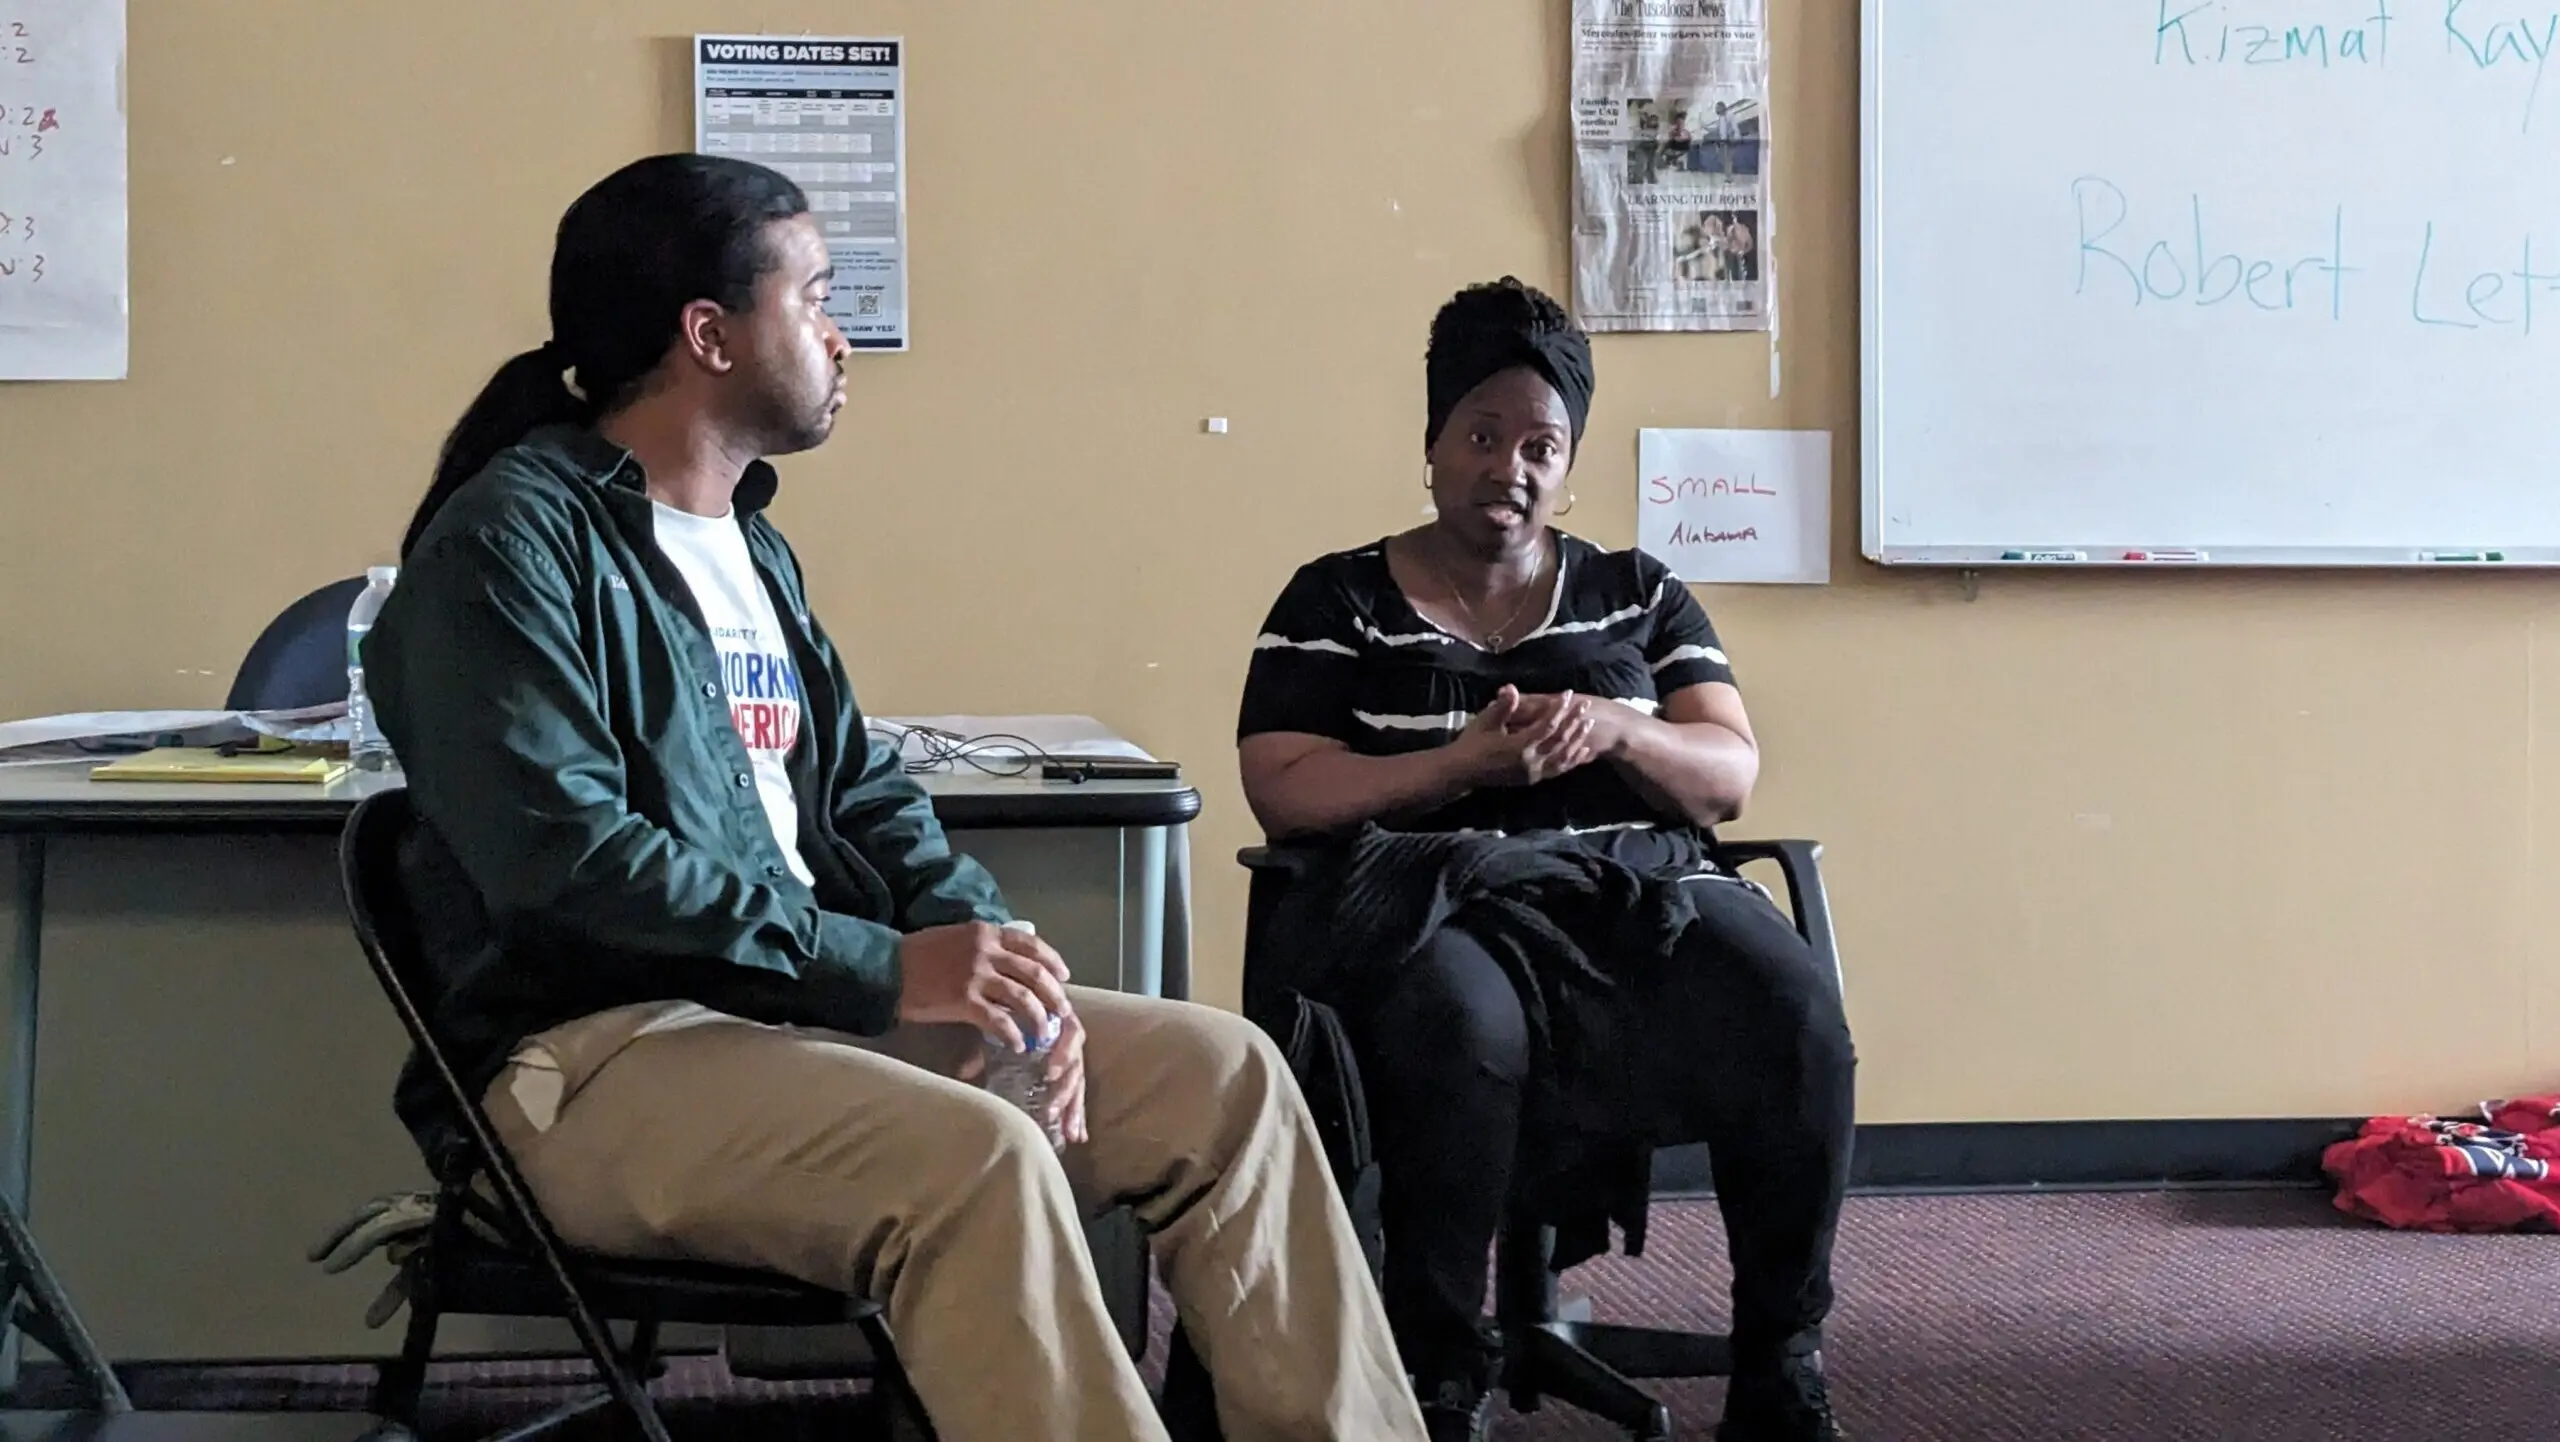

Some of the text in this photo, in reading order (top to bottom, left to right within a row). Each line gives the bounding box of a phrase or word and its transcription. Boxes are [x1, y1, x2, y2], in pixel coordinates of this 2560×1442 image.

[1612, 0, 1726, 18] The Tuscaloosa News
[11, 21, 30, 37] 2
[1660, 31, 1700, 39] workers
[1721, 30, 1732, 39] to
[1734, 31, 1756, 39] vote
[15, 47, 36, 63] 2
[706, 43, 891, 62] VOTING DATES SET!
[1628, 193, 1757, 206] LEARNING THE ROPES
[2070, 174, 2560, 338] Robert Let
[1648, 471, 1777, 505] SMALL
